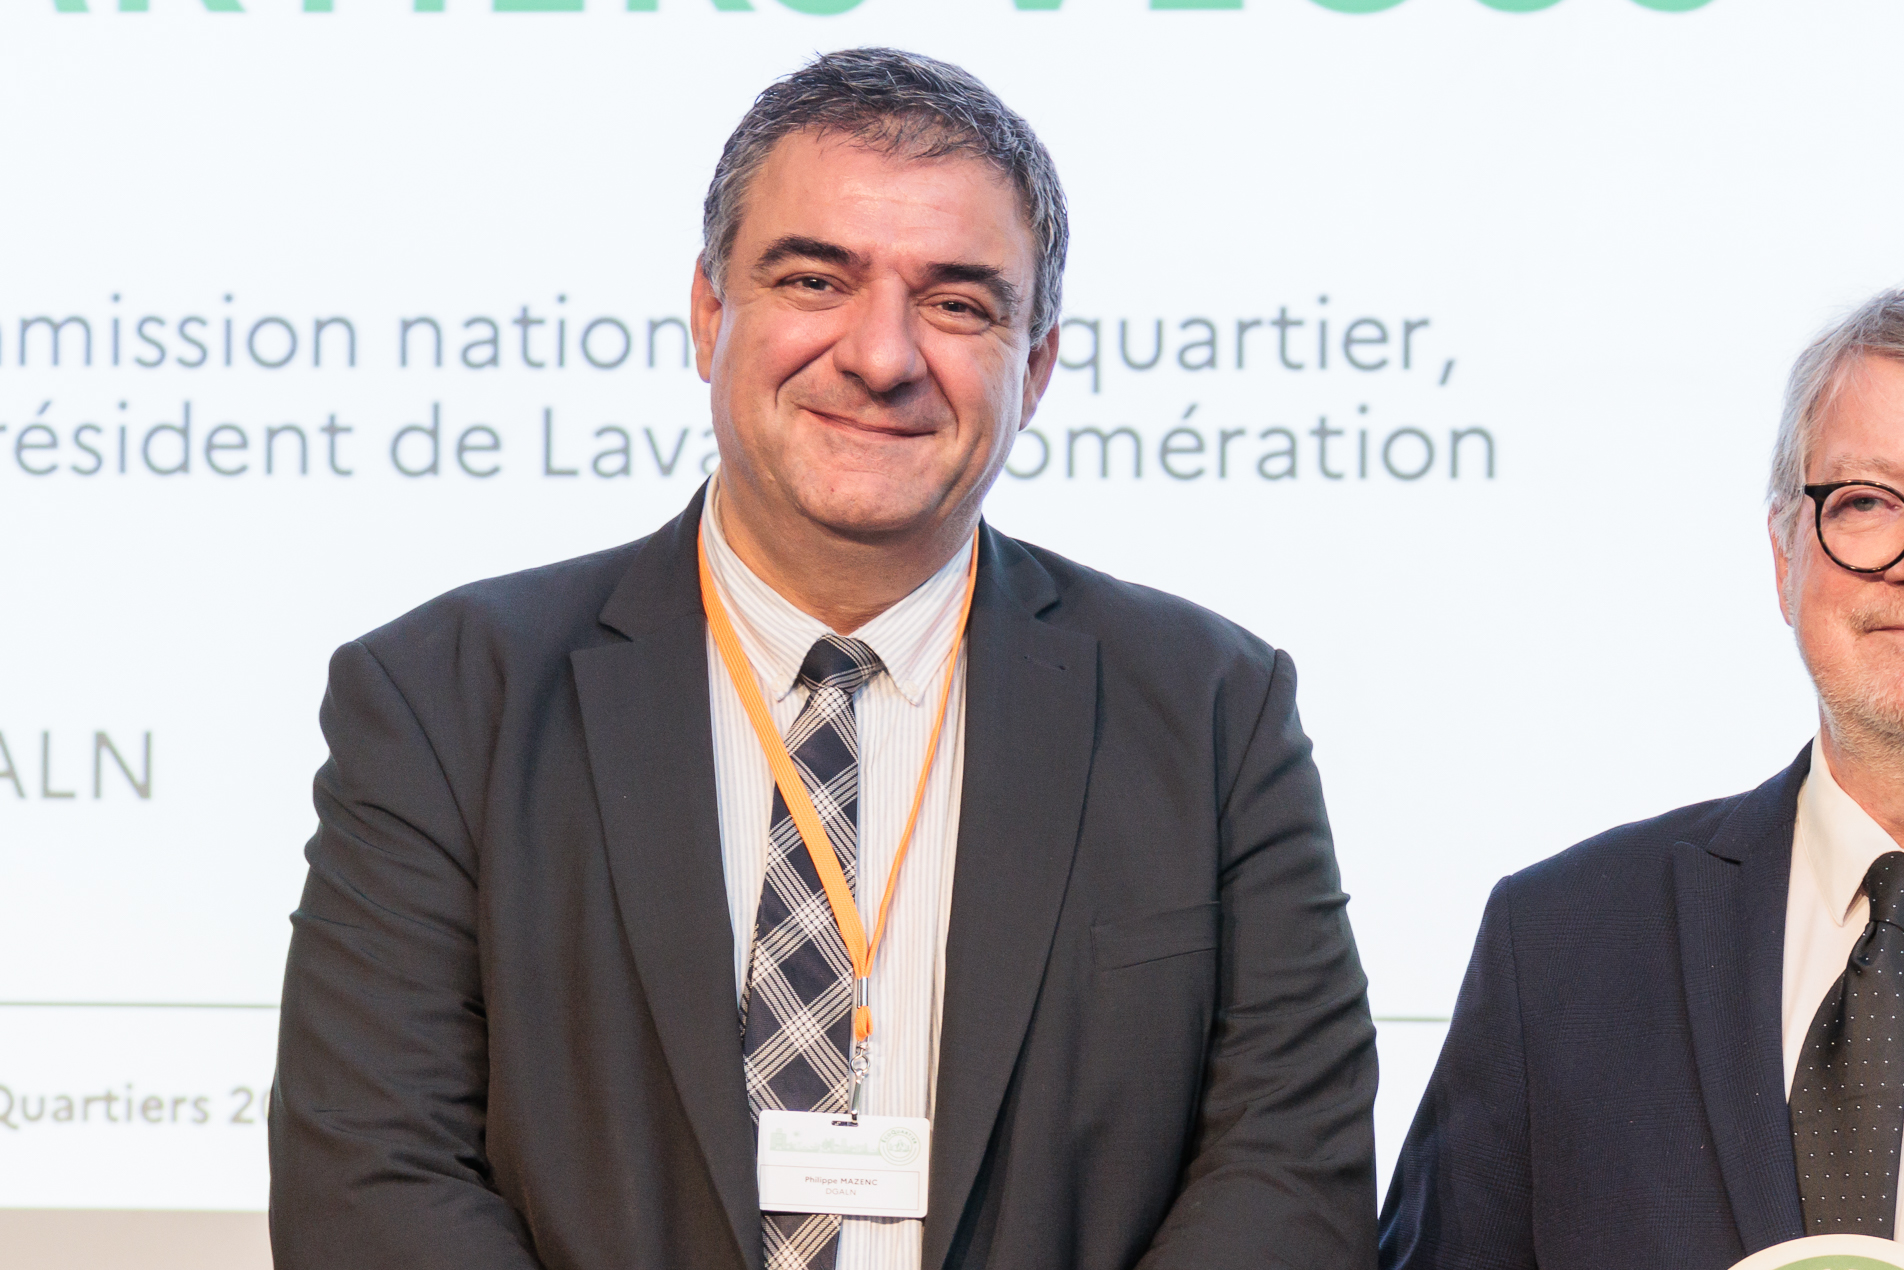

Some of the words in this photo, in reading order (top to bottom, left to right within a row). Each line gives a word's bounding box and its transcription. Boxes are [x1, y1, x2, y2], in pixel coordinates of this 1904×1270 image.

[0, 293, 358, 370] mission
[0, 400, 354, 478] ésident
[389, 401, 503, 479] de
[805, 1176, 838, 1186] Philippe
[840, 1178, 878, 1187] MAZENC
[825, 1187, 857, 1196] DGALN
